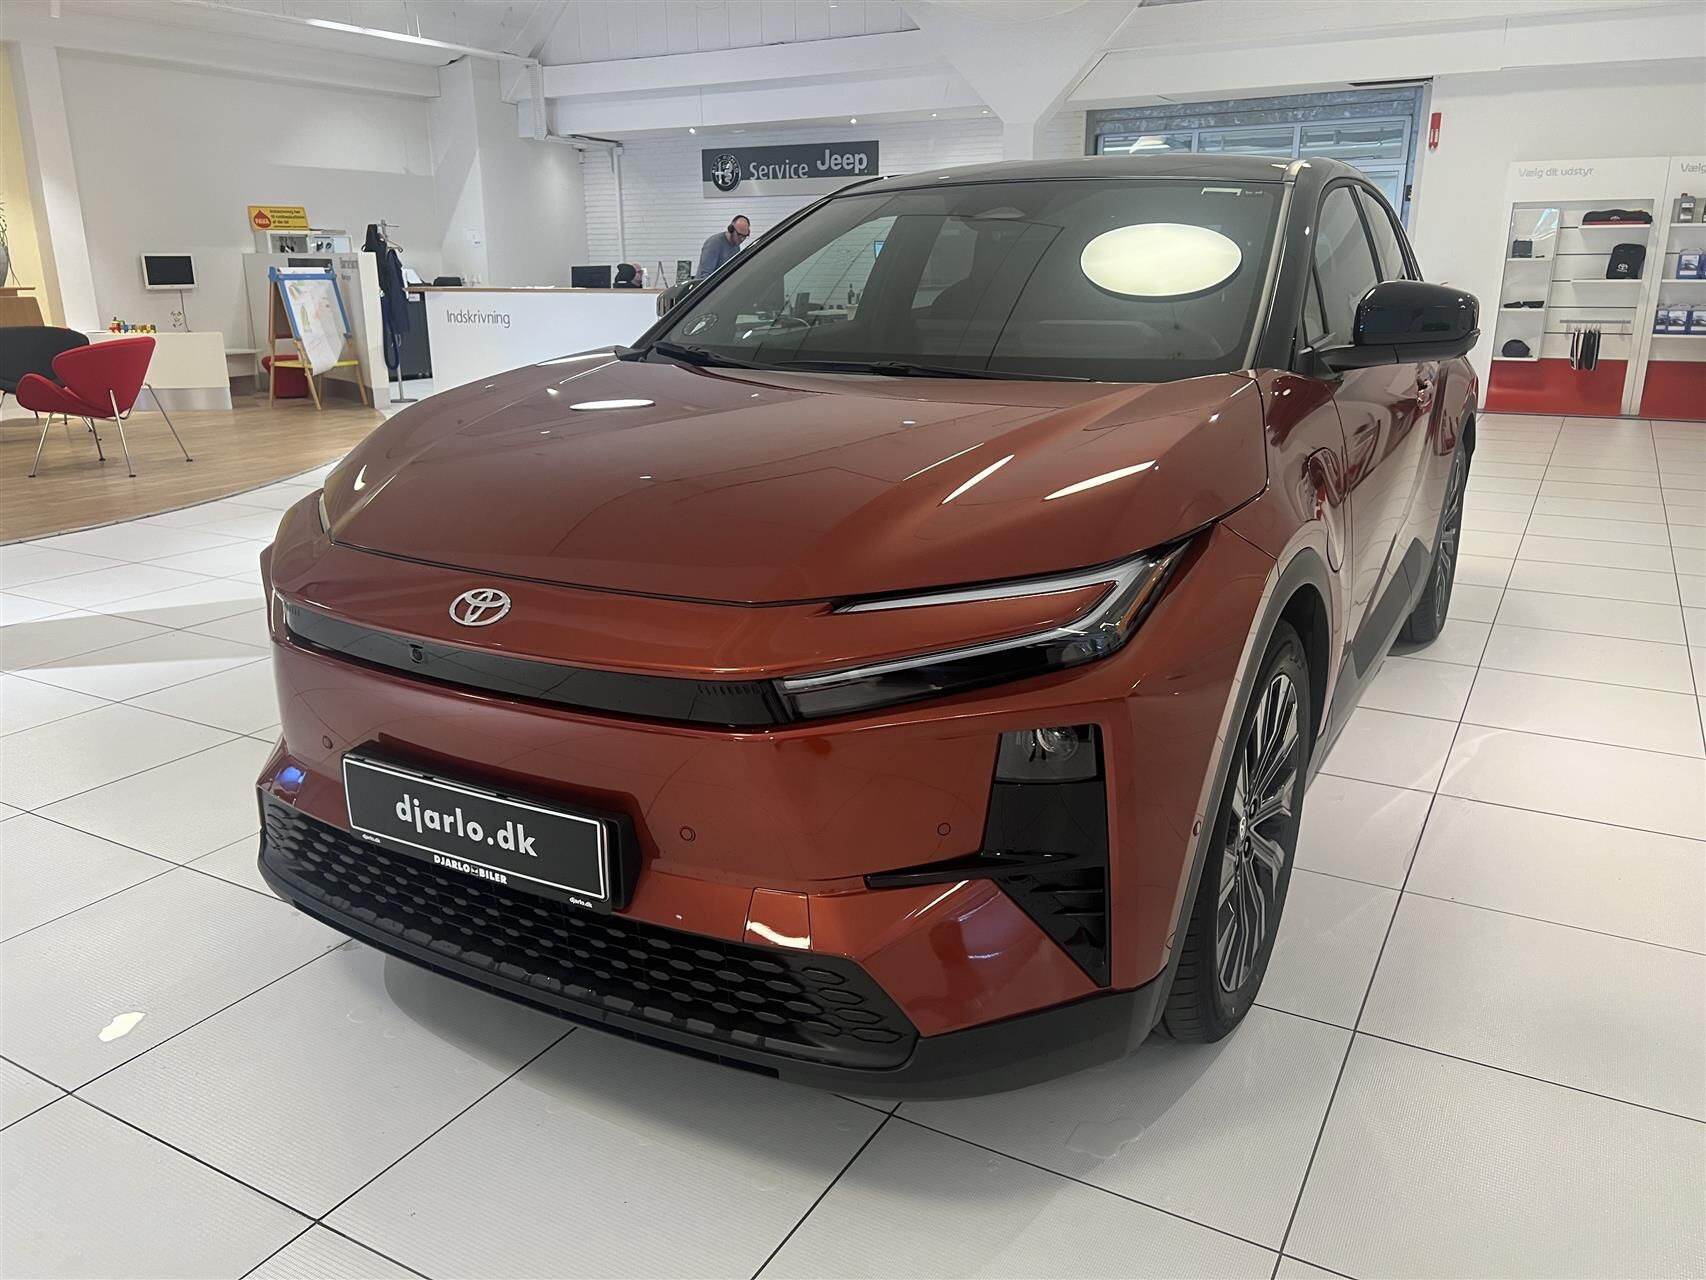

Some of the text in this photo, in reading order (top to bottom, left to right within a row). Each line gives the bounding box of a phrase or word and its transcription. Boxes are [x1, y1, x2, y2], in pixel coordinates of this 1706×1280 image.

[749, 149, 868, 180] Service Jeep
[1518, 166, 1594, 179] Vælg dit udstyr
[446, 308, 511, 329] Indskrivning
[395, 793, 538, 857] djarlo.dk
[433, 854, 508, 885] DJARLO BILER
[569, 896, 593, 908] djarlo.dk
